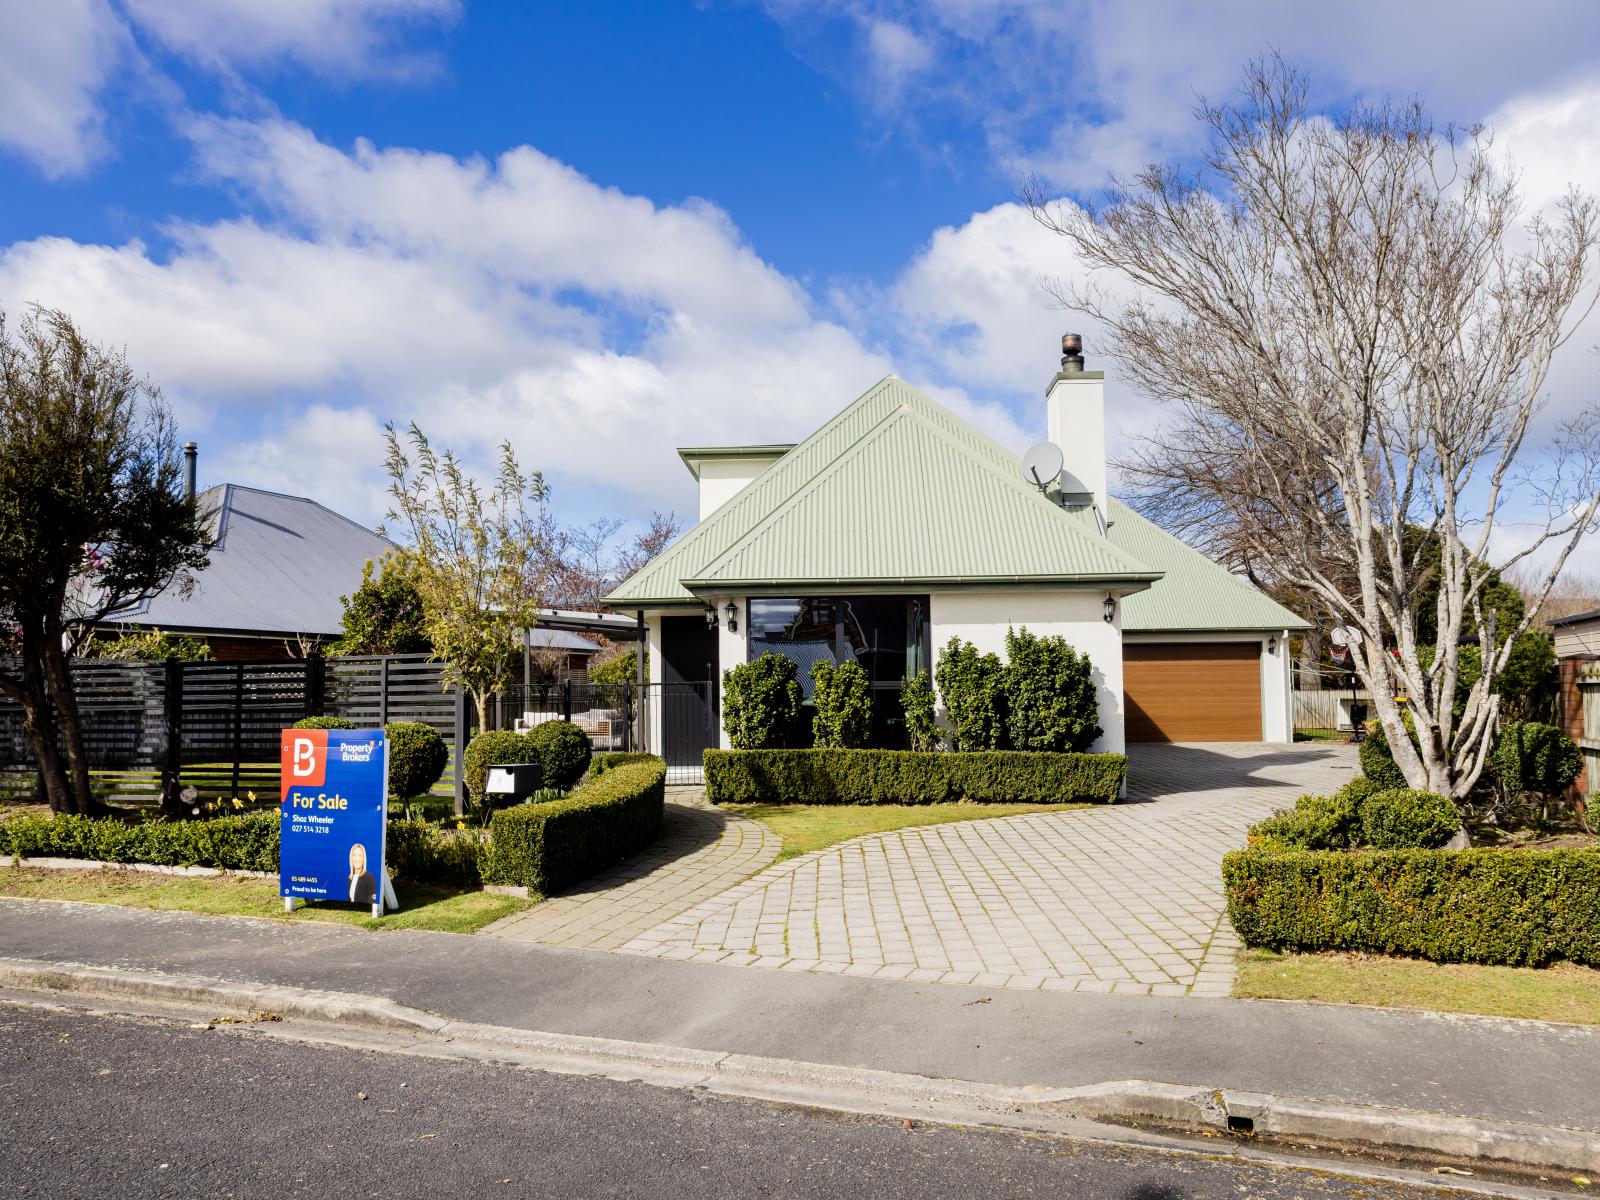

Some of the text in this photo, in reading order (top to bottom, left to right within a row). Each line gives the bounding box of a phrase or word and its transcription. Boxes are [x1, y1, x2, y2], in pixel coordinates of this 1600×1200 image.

[340, 743, 373, 754] Property
[293, 738, 315, 776] B
[342, 752, 370, 761] Brokers
[293, 792, 348, 810] For Sale
[292, 814, 334, 824] Shoz Wheeler
